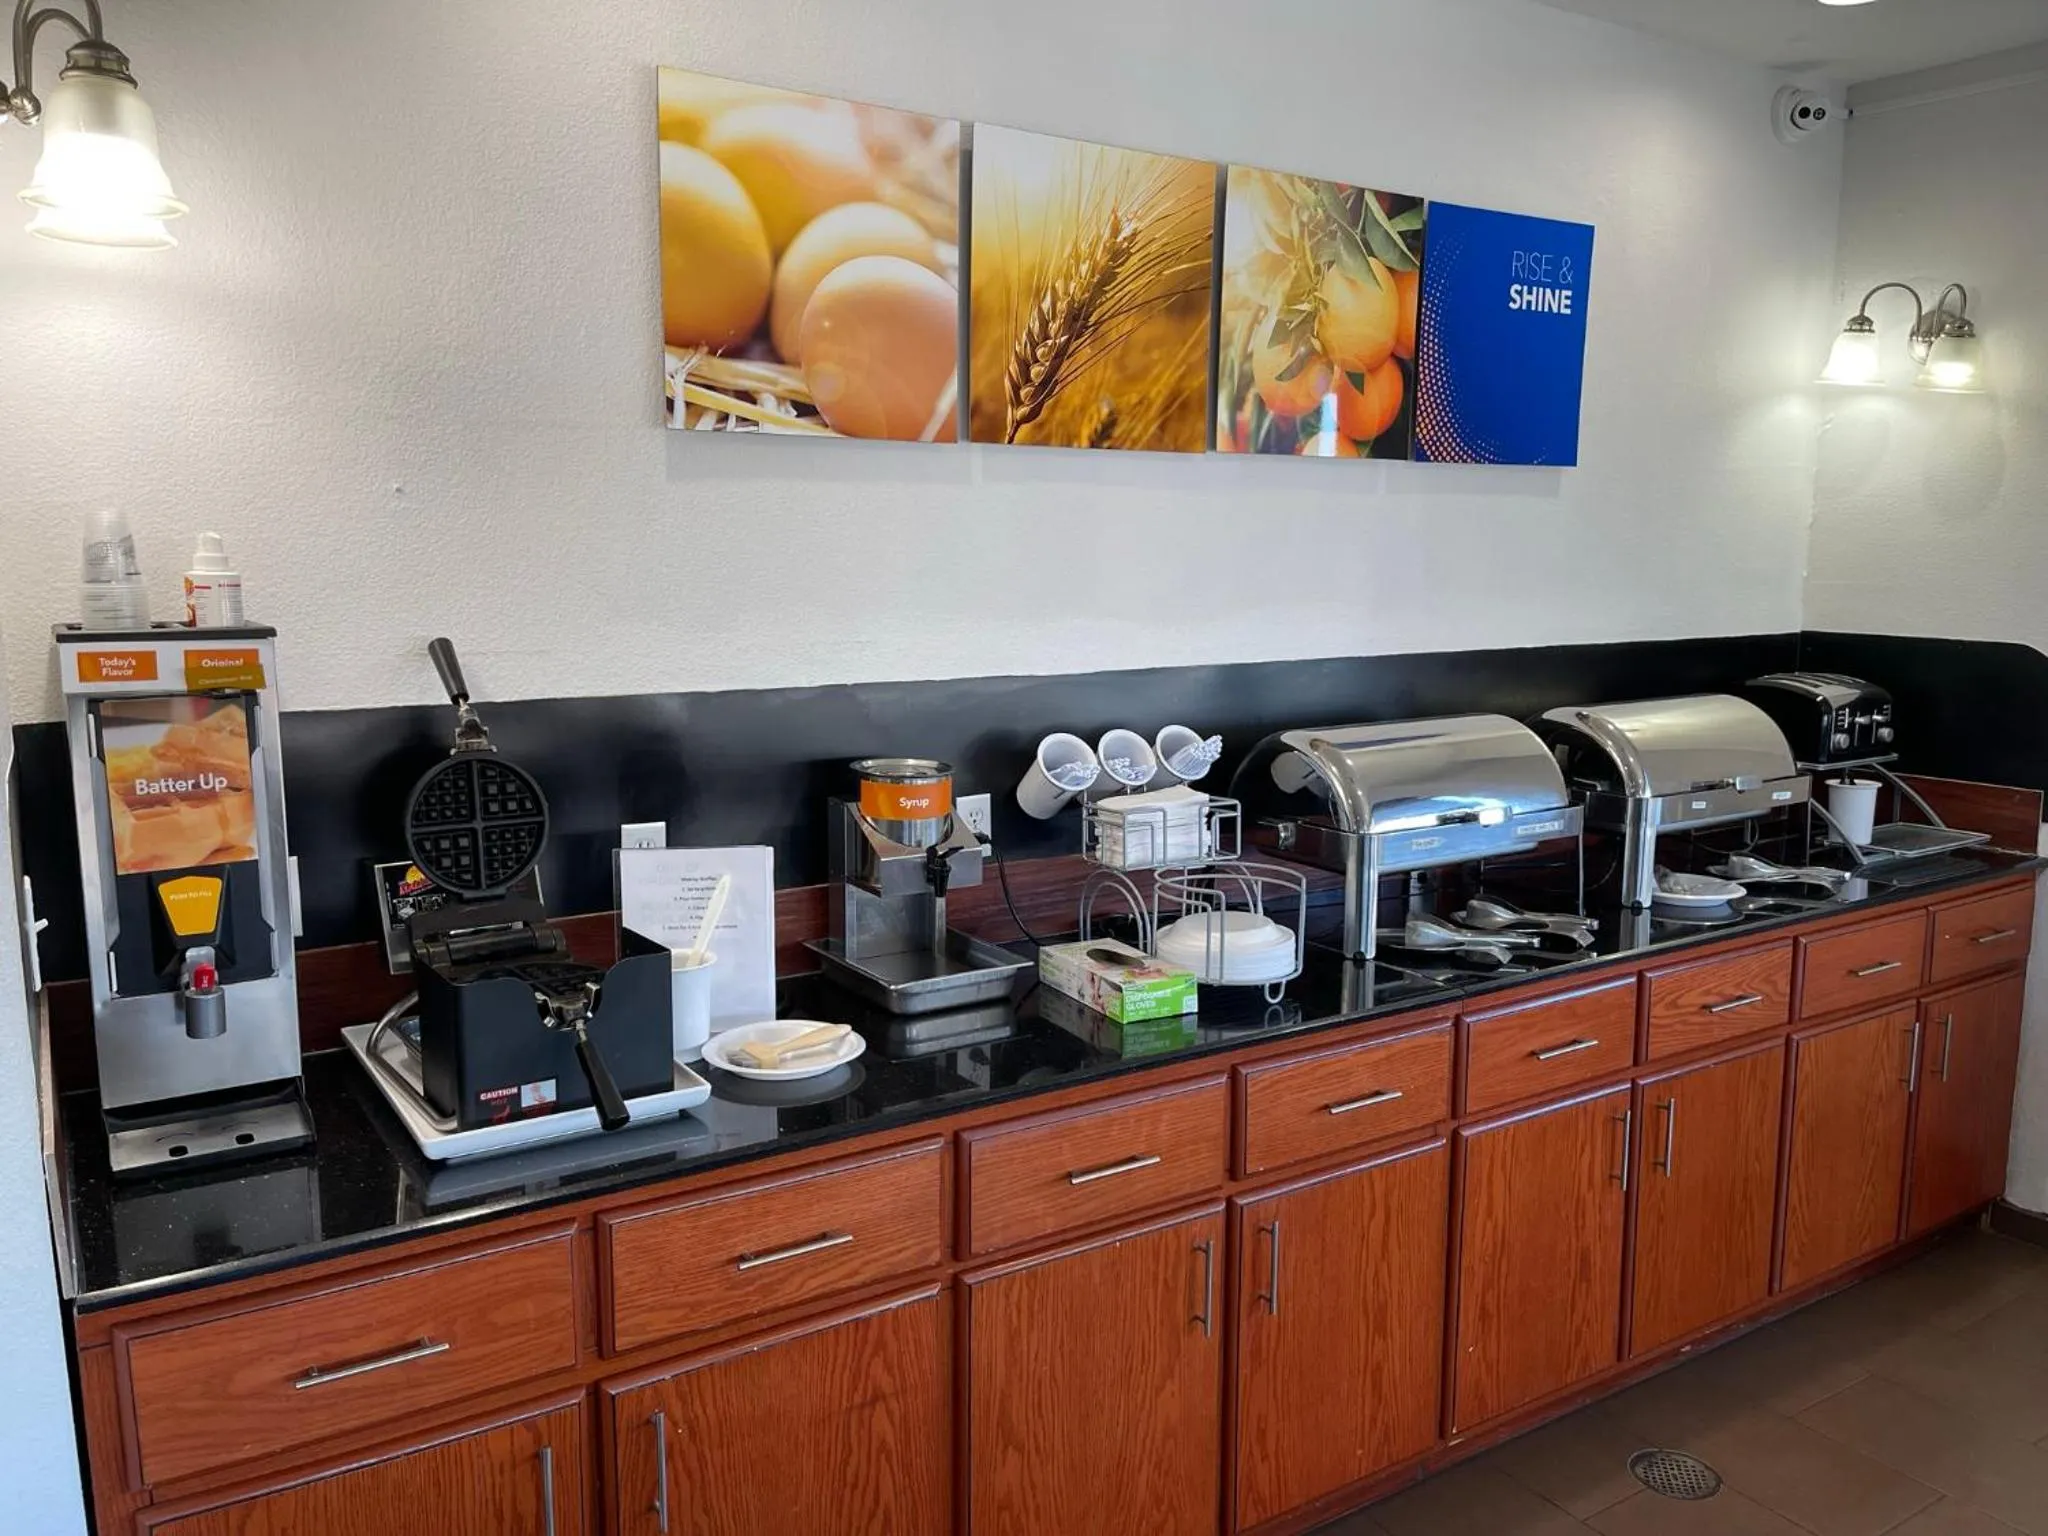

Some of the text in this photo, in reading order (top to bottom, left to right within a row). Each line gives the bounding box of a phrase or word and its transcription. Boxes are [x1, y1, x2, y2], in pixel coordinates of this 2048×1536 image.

[1511, 250, 1574, 284] RISE &
[1508, 283, 1573, 315] SHINE
[99, 657, 136, 667] Today's
[102, 667, 134, 677] Flavor
[135, 772, 228, 796] Batter Up
[899, 796, 930, 809] Syrup
[480, 1086, 519, 1101] CAUTION
